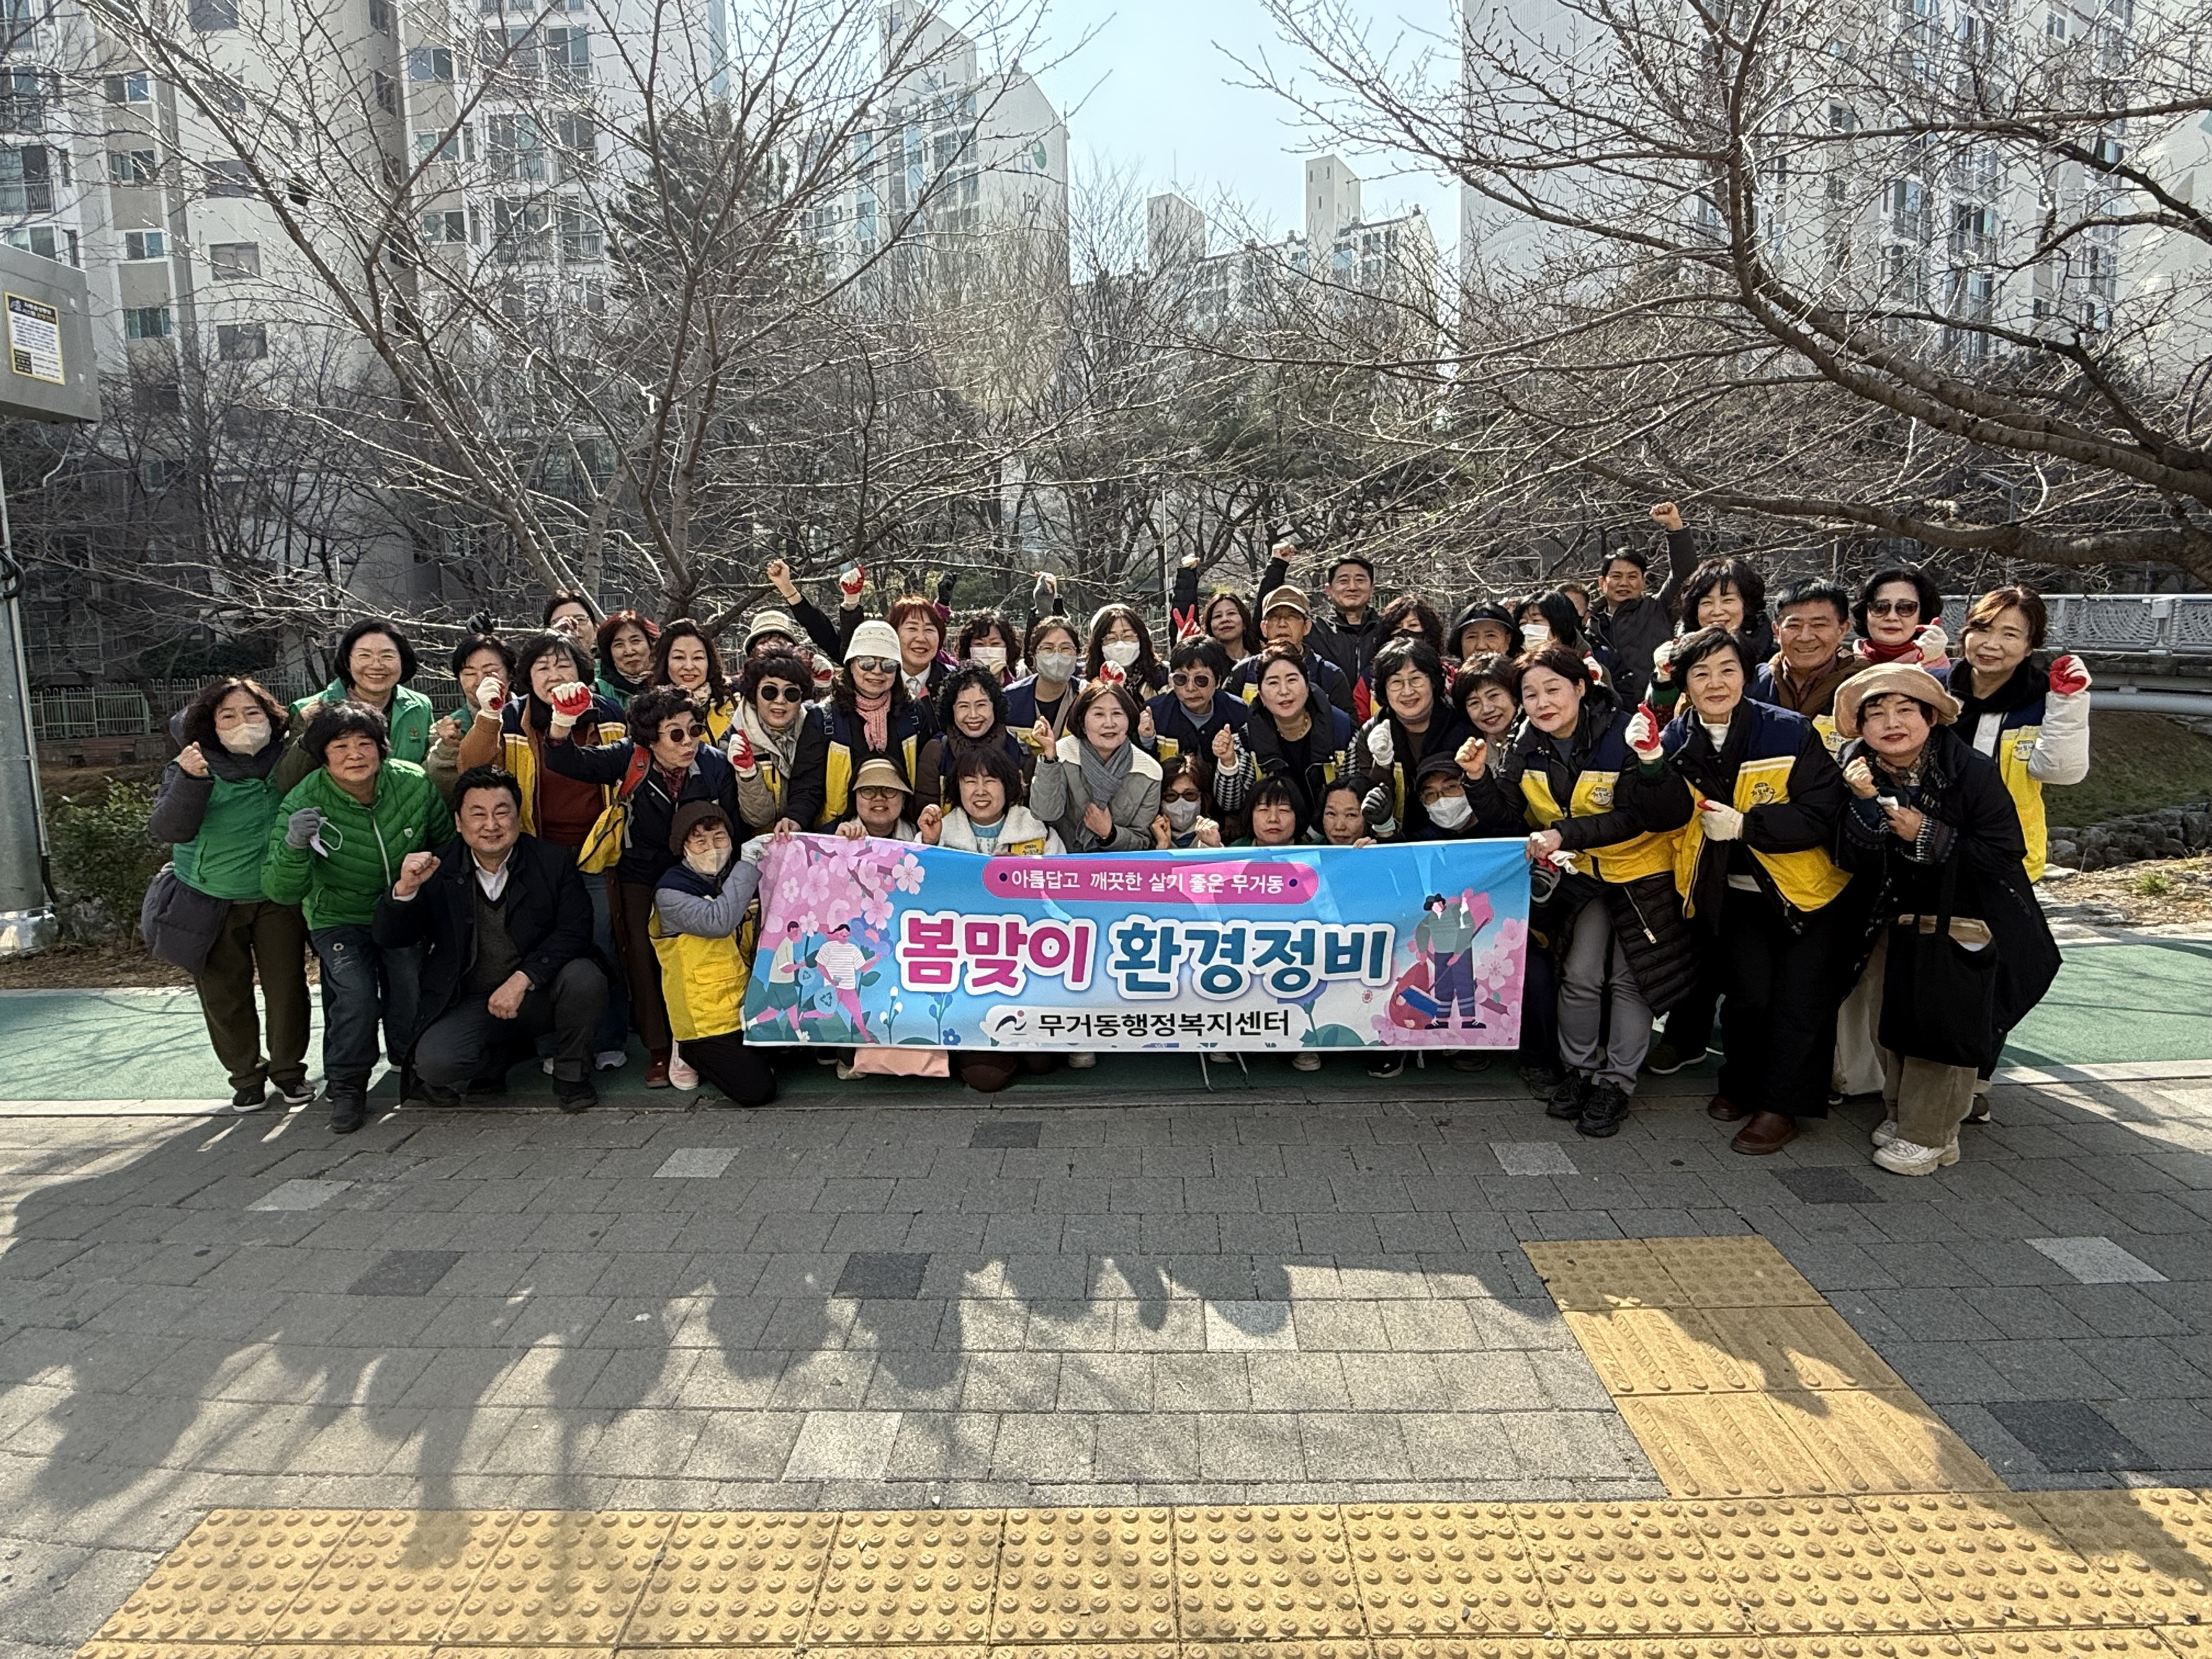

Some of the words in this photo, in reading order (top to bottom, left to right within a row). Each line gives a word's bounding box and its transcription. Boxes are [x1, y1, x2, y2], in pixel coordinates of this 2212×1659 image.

[1011, 869, 1080, 889] 아름답고
[1090, 871, 1142, 891] 깨끗한
[1149, 872, 1183, 893] 살기
[1189, 873, 1224, 894] 좋은
[1231, 874, 1284, 894] 무거동
[902, 917, 1090, 989] 봄맞이
[1114, 922, 1388, 994] 환경정비
[1038, 1009, 1290, 1037] 무거동행정복지센터
